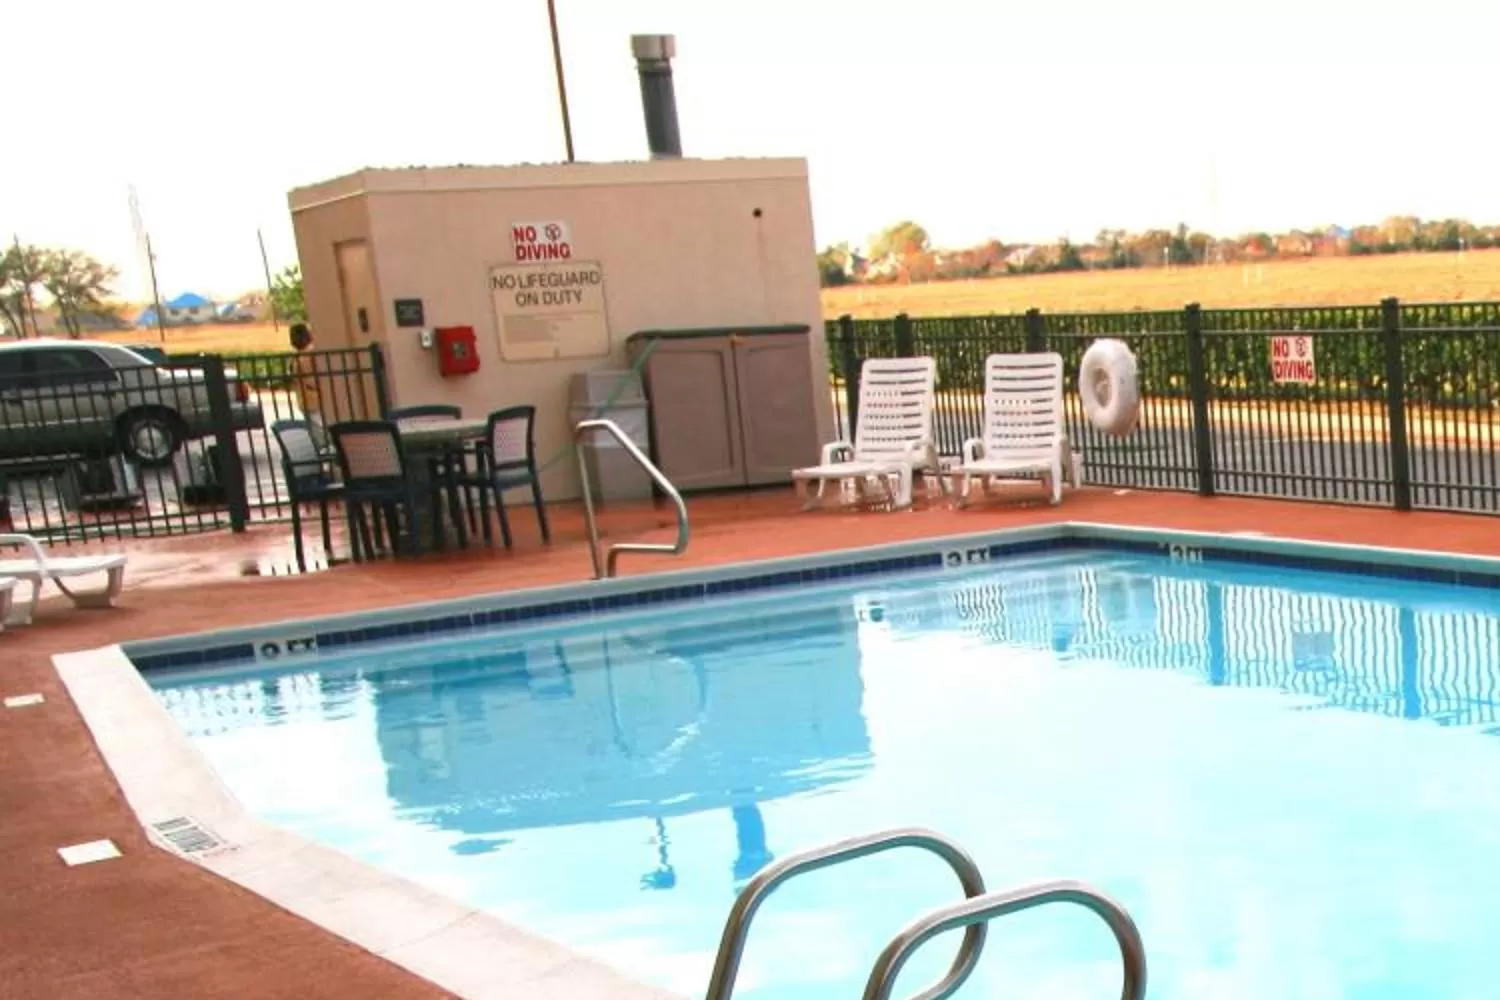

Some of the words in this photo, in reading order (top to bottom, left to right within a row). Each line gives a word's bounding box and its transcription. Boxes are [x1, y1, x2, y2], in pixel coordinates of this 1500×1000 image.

[513, 226, 537, 242] NO
[515, 243, 571, 260] DIVING
[492, 275, 516, 289] NO
[518, 271, 600, 289] LIFEGUARD
[515, 291, 538, 308] ON
[542, 289, 582, 305] DUTY
[1273, 338, 1289, 357] NO
[1274, 360, 1313, 379] DIVING
